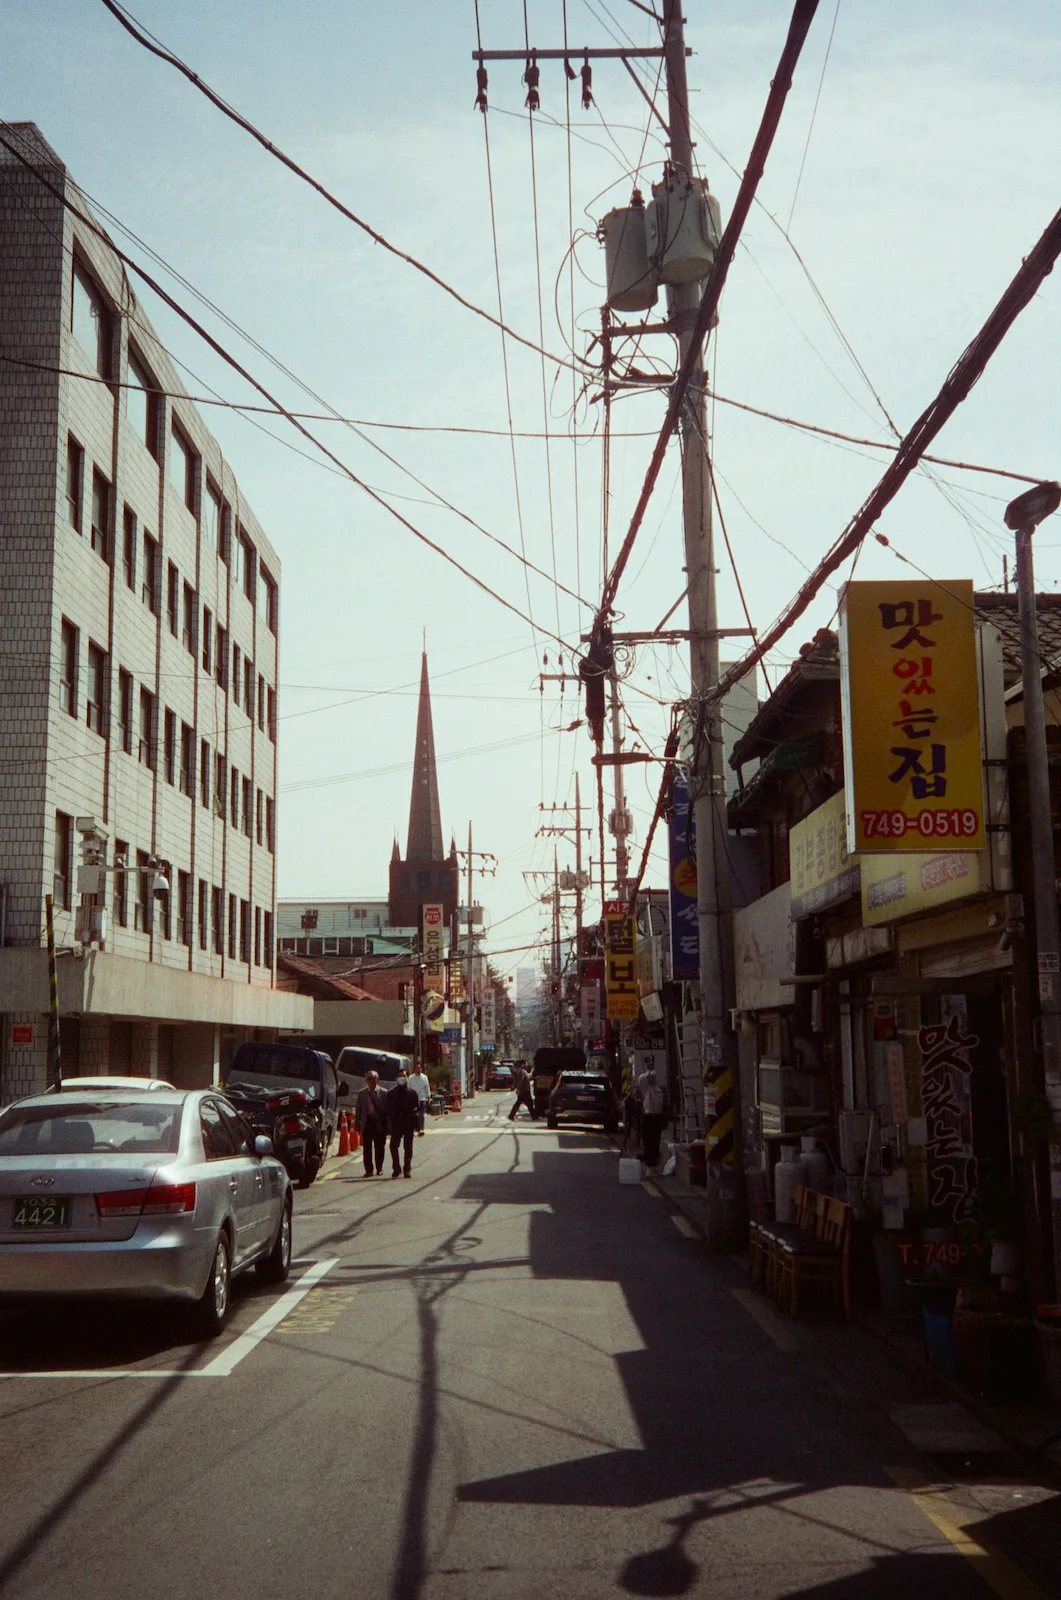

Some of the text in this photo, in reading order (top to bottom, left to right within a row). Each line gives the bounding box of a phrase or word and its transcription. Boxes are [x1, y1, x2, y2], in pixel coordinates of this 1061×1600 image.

[862, 810, 977, 836] 749-0519
[608, 919, 636, 994] 털보
[14, 1207, 65, 1225] 4421
